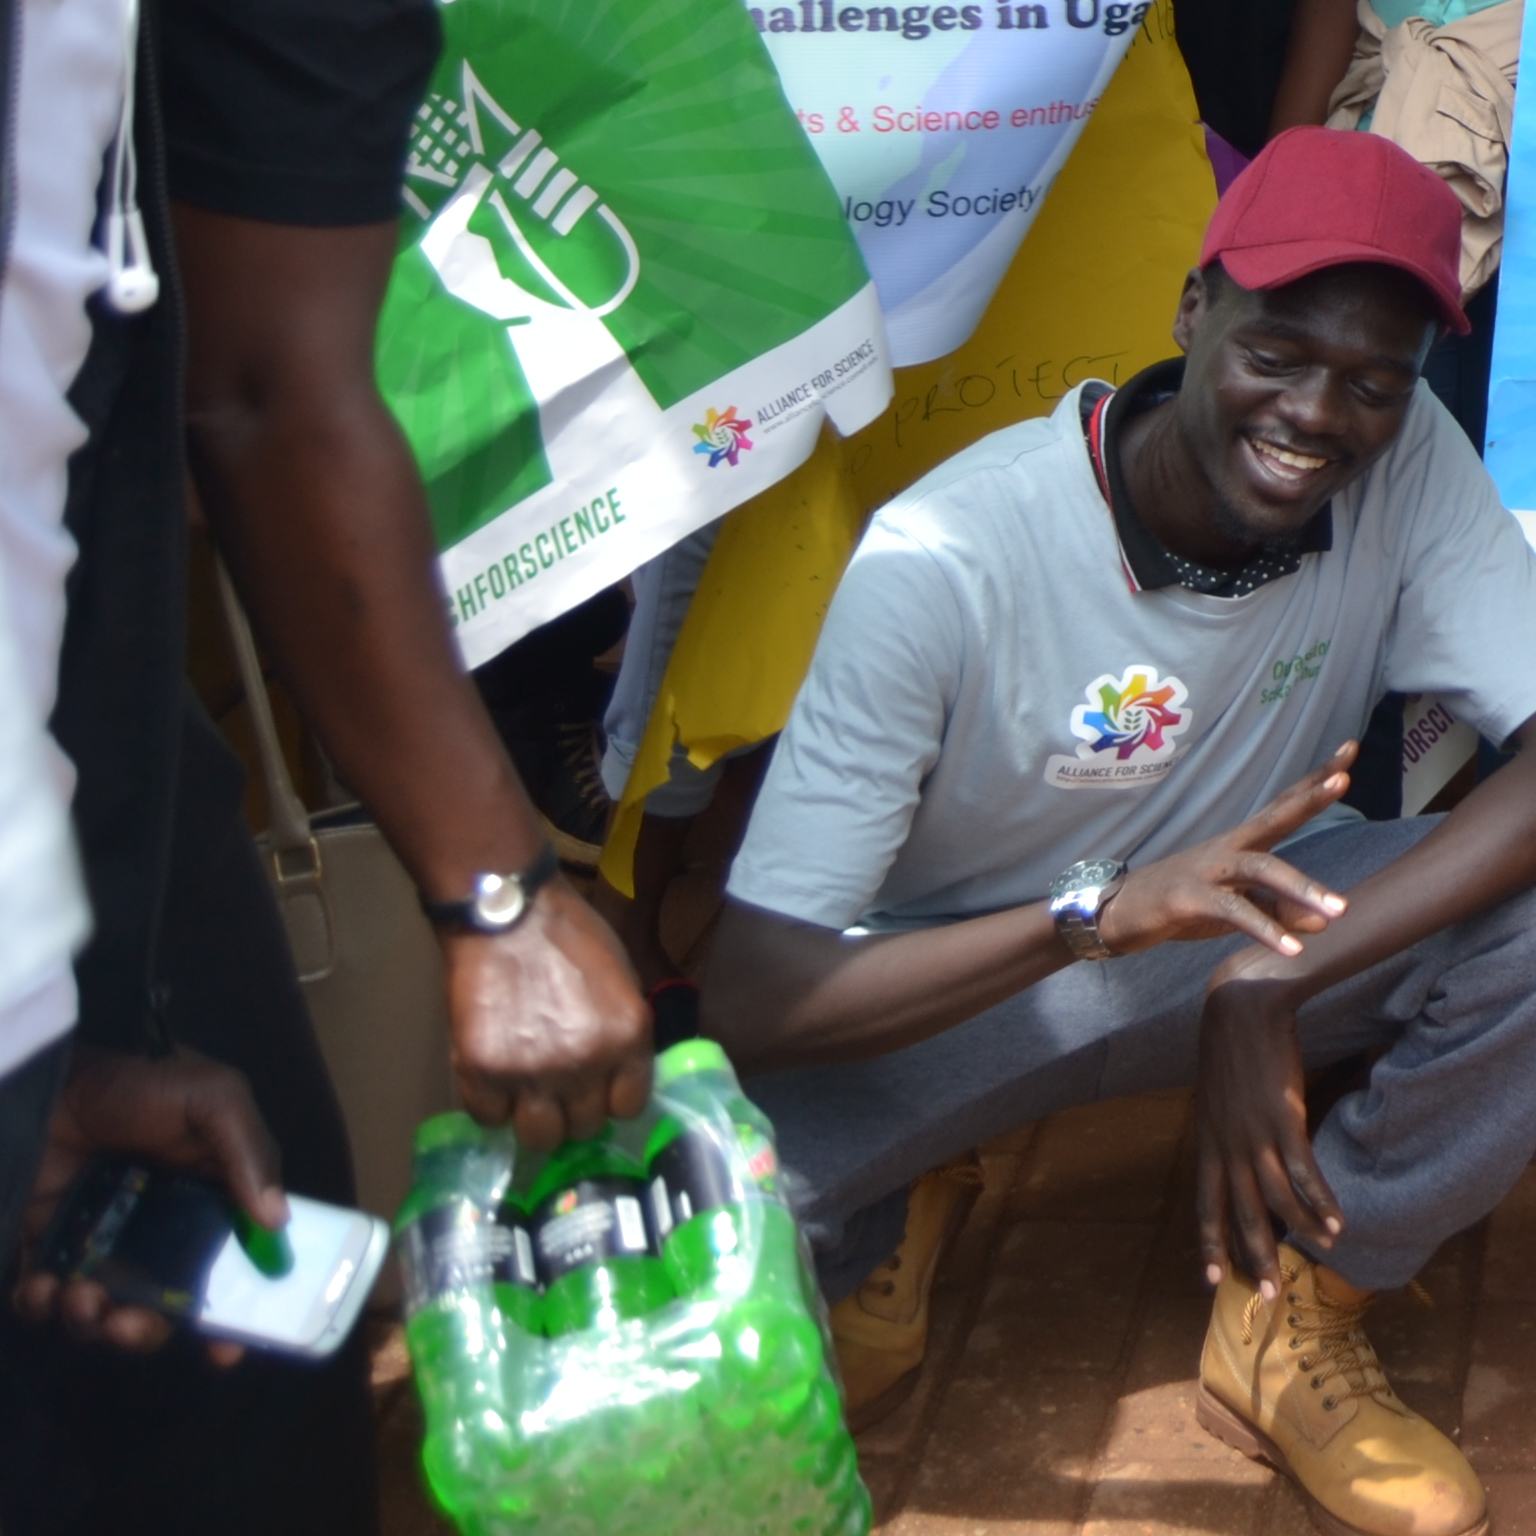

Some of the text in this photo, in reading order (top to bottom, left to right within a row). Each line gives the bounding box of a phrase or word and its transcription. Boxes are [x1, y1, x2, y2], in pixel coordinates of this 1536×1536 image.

[837, 105, 861, 133] &
[872, 104, 1002, 133] Science
[927, 185, 1042, 218] Society
[756, 338, 875, 426] ALLIANCE FOR SCIENCE
[1056, 764, 1113, 778] ALLIANCE
[1114, 764, 1138, 777] FOR
